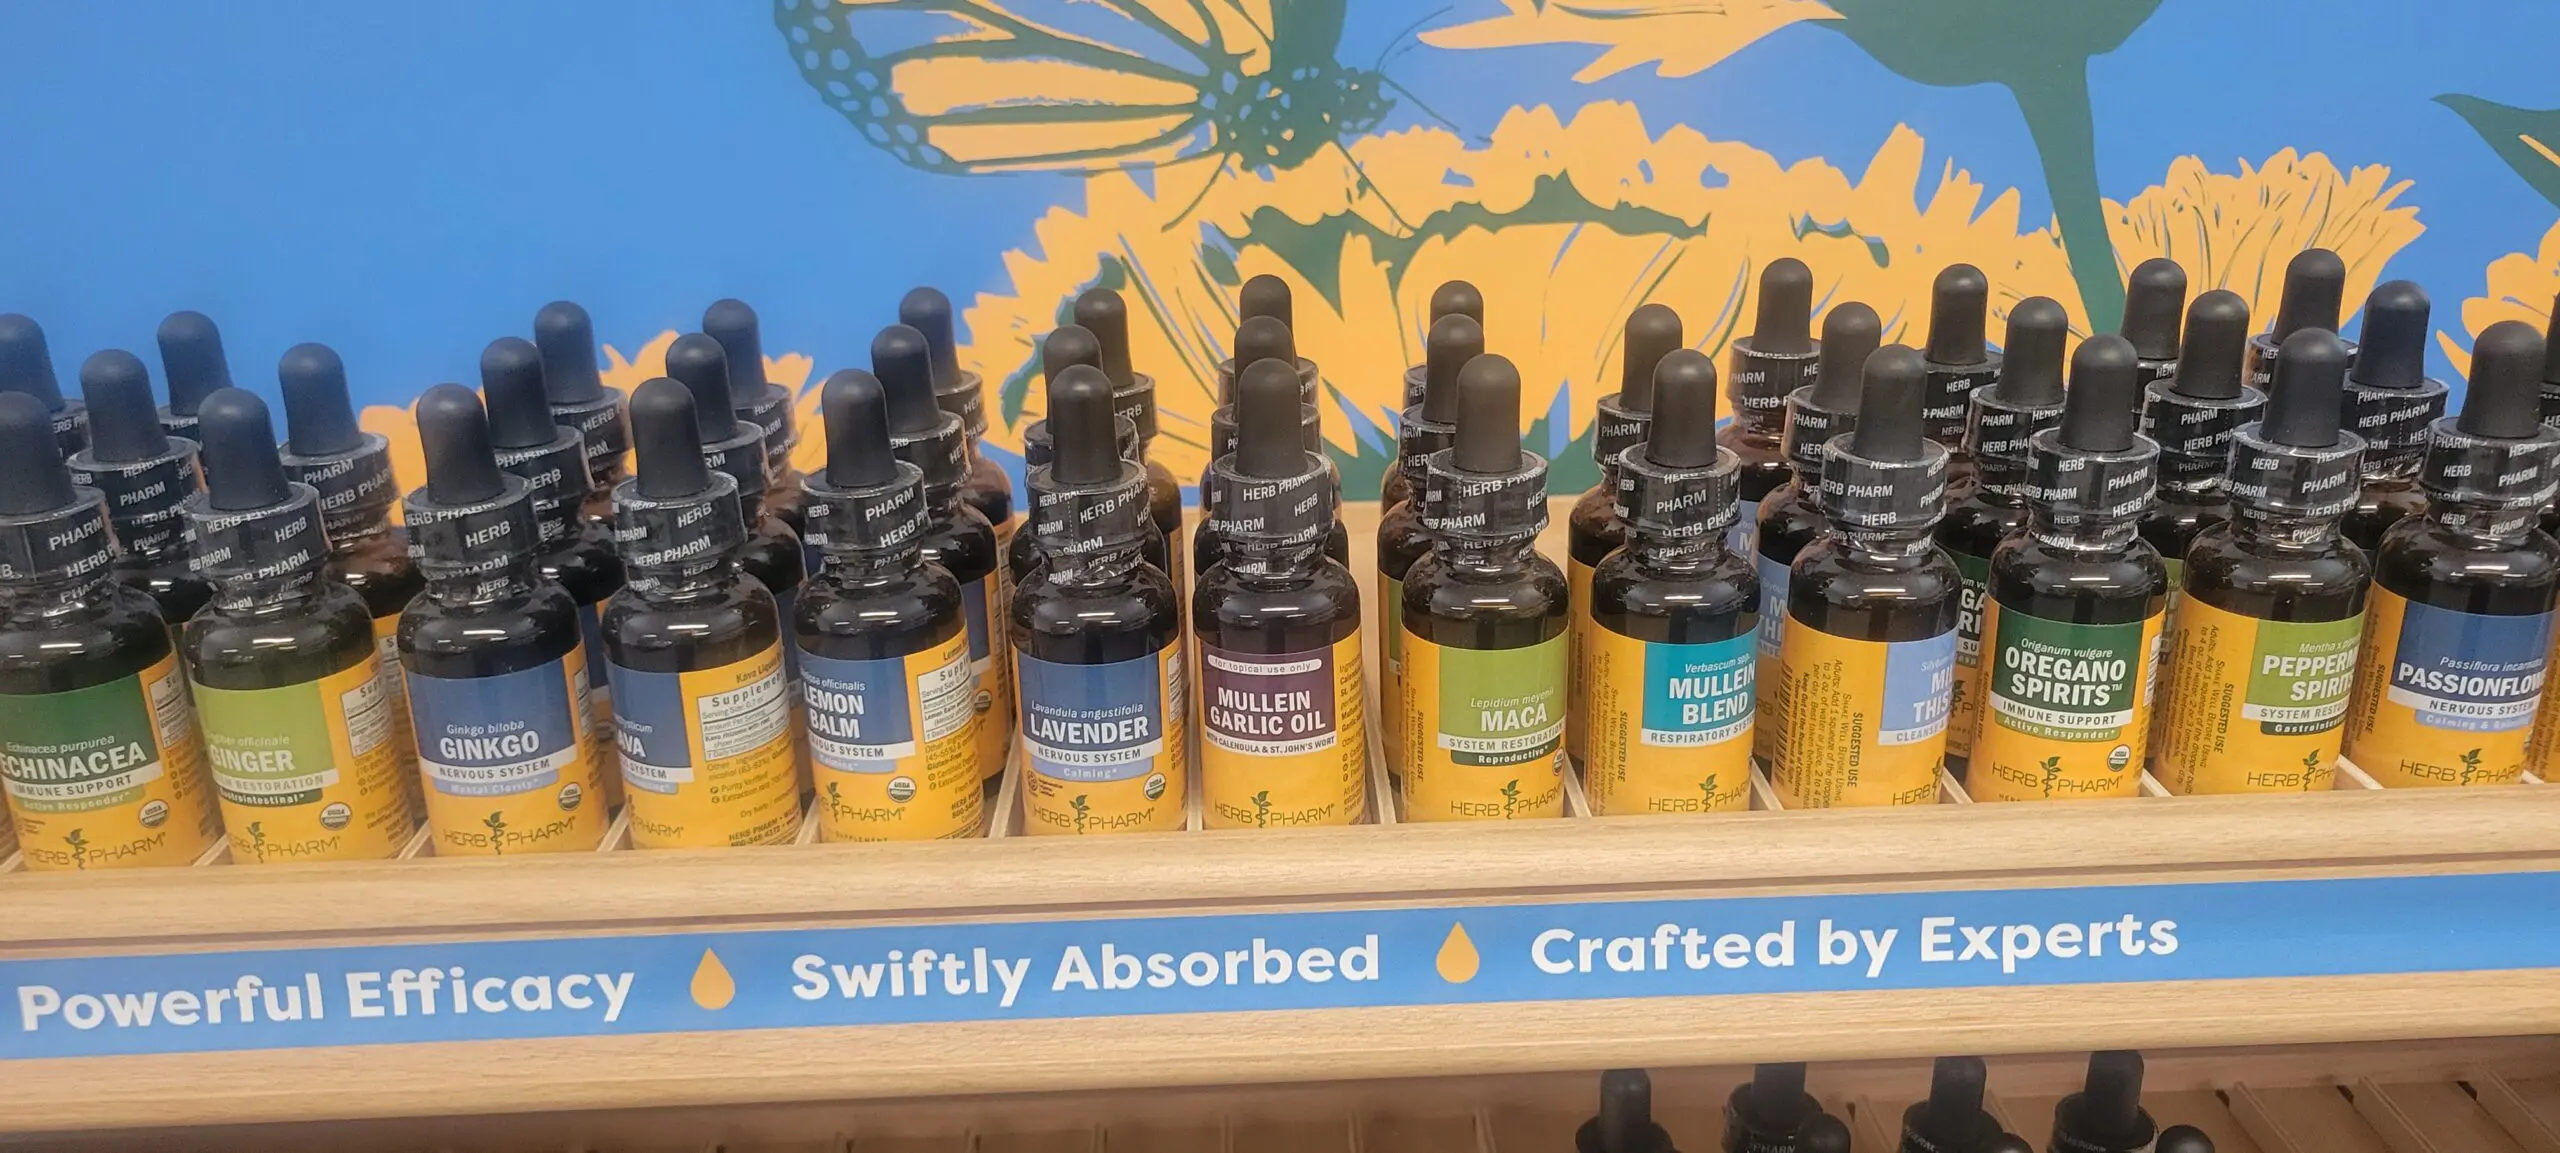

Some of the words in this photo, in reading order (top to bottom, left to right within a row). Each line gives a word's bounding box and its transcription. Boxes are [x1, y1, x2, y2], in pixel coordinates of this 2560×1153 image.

[1946, 378, 1971, 393] HERB
[1981, 414, 2014, 426] PHARM
[2181, 408, 2218, 425] PHARM
[2358, 414, 2387, 428] HERB
[2390, 402, 2430, 422] PHARM
[1601, 422, 1641, 437] PHARM
[304, 458, 354, 484] PHARM
[2058, 457, 2085, 472] HERB
[2252, 457, 2279, 471] HERB
[2443, 465, 2472, 477] HERB
[2108, 467, 2148, 491] PHARM
[2302, 470, 2347, 493] PHARM
[2499, 466, 2538, 487] PHARM
[120, 481, 166, 506] PHARM
[1656, 489, 1707, 514] PHARM
[1847, 484, 1893, 498] PHARM
[2043, 487, 2078, 500] PHARM
[865, 487, 914, 521] PHARM
[1080, 499, 1115, 524] HERB
[677, 502, 713, 528] HERB
[1440, 513, 1486, 529] PHARM
[50, 516, 103, 550] PHARM
[275, 517, 308, 543] HERB
[465, 520, 511, 548] HERB
[2021, 638, 2071, 657] Origanum
[2074, 648, 2113, 661] vulgare
[2299, 642, 2335, 653] Mentha
[1214, 658, 1226, 668] for
[1229, 663, 1263, 673] topical
[1267, 664, 1285, 673] use
[1290, 662, 1311, 672] only
[1685, 659, 1736, 673] Verbascum
[2005, 647, 2127, 682] OREGANO
[2440, 656, 2500, 672] Passiflora
[736, 670, 756, 683] Kava
[822, 679, 866, 691] officinalis
[1669, 660, 1756, 699] MULLEIN
[803, 682, 865, 715] LEMON
[1218, 686, 1311, 712] MULLEIN
[2370, 663, 2385, 714] SUGGESTED
[1032, 701, 1077, 718] Lavandula
[1081, 703, 1143, 720] angustifolia
[1471, 697, 1519, 709] Lepidium
[1682, 692, 1748, 725] BLEND
[2003, 701, 2053, 722] IMMUNE
[2058, 714, 2116, 725] SUPPORT
[2218, 683, 2234, 734] SUGGESTED
[2260, 708, 2310, 719] SYSTEM
[2429, 700, 2494, 715] NERVOUS
[809, 708, 860, 739] BALM
[1210, 706, 1283, 735] GARLIC
[1291, 711, 1326, 734] OIL
[1481, 703, 1547, 732] MACA
[2004, 716, 2039, 734] Active
[2366, 716, 2376, 734] USE
[2426, 714, 2475, 730] Calming
[2480, 721, 2488, 729] &
[447, 724, 484, 736] Ginkgo
[489, 721, 524, 733] biloba
[1030, 713, 1149, 744] LAVENDER
[1449, 738, 1495, 750] SYSTEM
[1501, 723, 1563, 749] RESTORATION
[1619, 711, 1628, 760] SUGGESTED
[1651, 727, 1731, 743] RESPIRATORY
[1850, 712, 1863, 766] SUGGESTED
[7, 742, 57, 754] Echinacea
[61, 736, 114, 753] purpurea
[238, 735, 290, 745] officinale
[440, 730, 539, 760] GINKGO
[840, 744, 884, 757] SYSTEM
[1219, 736, 1260, 753] CALENDULA
[1263, 745, 1268, 754] &
[1270, 745, 1283, 754] ST.
[1284, 742, 1313, 754] JOHN'S
[1315, 736, 1335, 748] WORT
[2214, 734, 2225, 753] USE
[1, 742, 147, 781] ECHINACEA
[210, 744, 295, 772] GINGER
[1038, 746, 1088, 763] NERVOUS
[1094, 749, 1141, 763] SYSTEM
[440, 767, 494, 779] NERVOUS
[500, 759, 550, 777] SYSTEM
[630, 764, 667, 779] SYSTEM
[1617, 761, 1627, 782] USE
[1847, 767, 1859, 788] USE
[1992, 762, 2038, 788] HERB
[2057, 777, 2120, 792] PHARM
[2247, 772, 2299, 787] HERB
[2400, 759, 2456, 782] HERB
[67, 775, 132, 795] SUPPORT
[236, 776, 324, 791] RESTORATION
[1649, 797, 1698, 812] HERB
[1893, 787, 1931, 806] HERB
[841, 806, 902, 821] PHARM
[1033, 804, 1071, 828] HERB
[1089, 810, 1151, 830] PHARM
[1215, 798, 1253, 824] HERB
[1270, 806, 1331, 826] PHARM
[1451, 800, 1500, 816] HERB
[444, 829, 488, 847] HERB
[507, 818, 572, 846] PHARM
[90, 834, 162, 862] PHARM
[267, 838, 337, 856] PHARM
[1531, 921, 1795, 974] Crafted
[1819, 919, 1899, 978] by
[1921, 912, 2179, 973] Experts
[792, 946, 1031, 1007] Swiftly
[1051, 934, 1380, 991] Absorbed
[18, 973, 325, 1033] Powerful
[346, 968, 634, 1022] Efficacy
